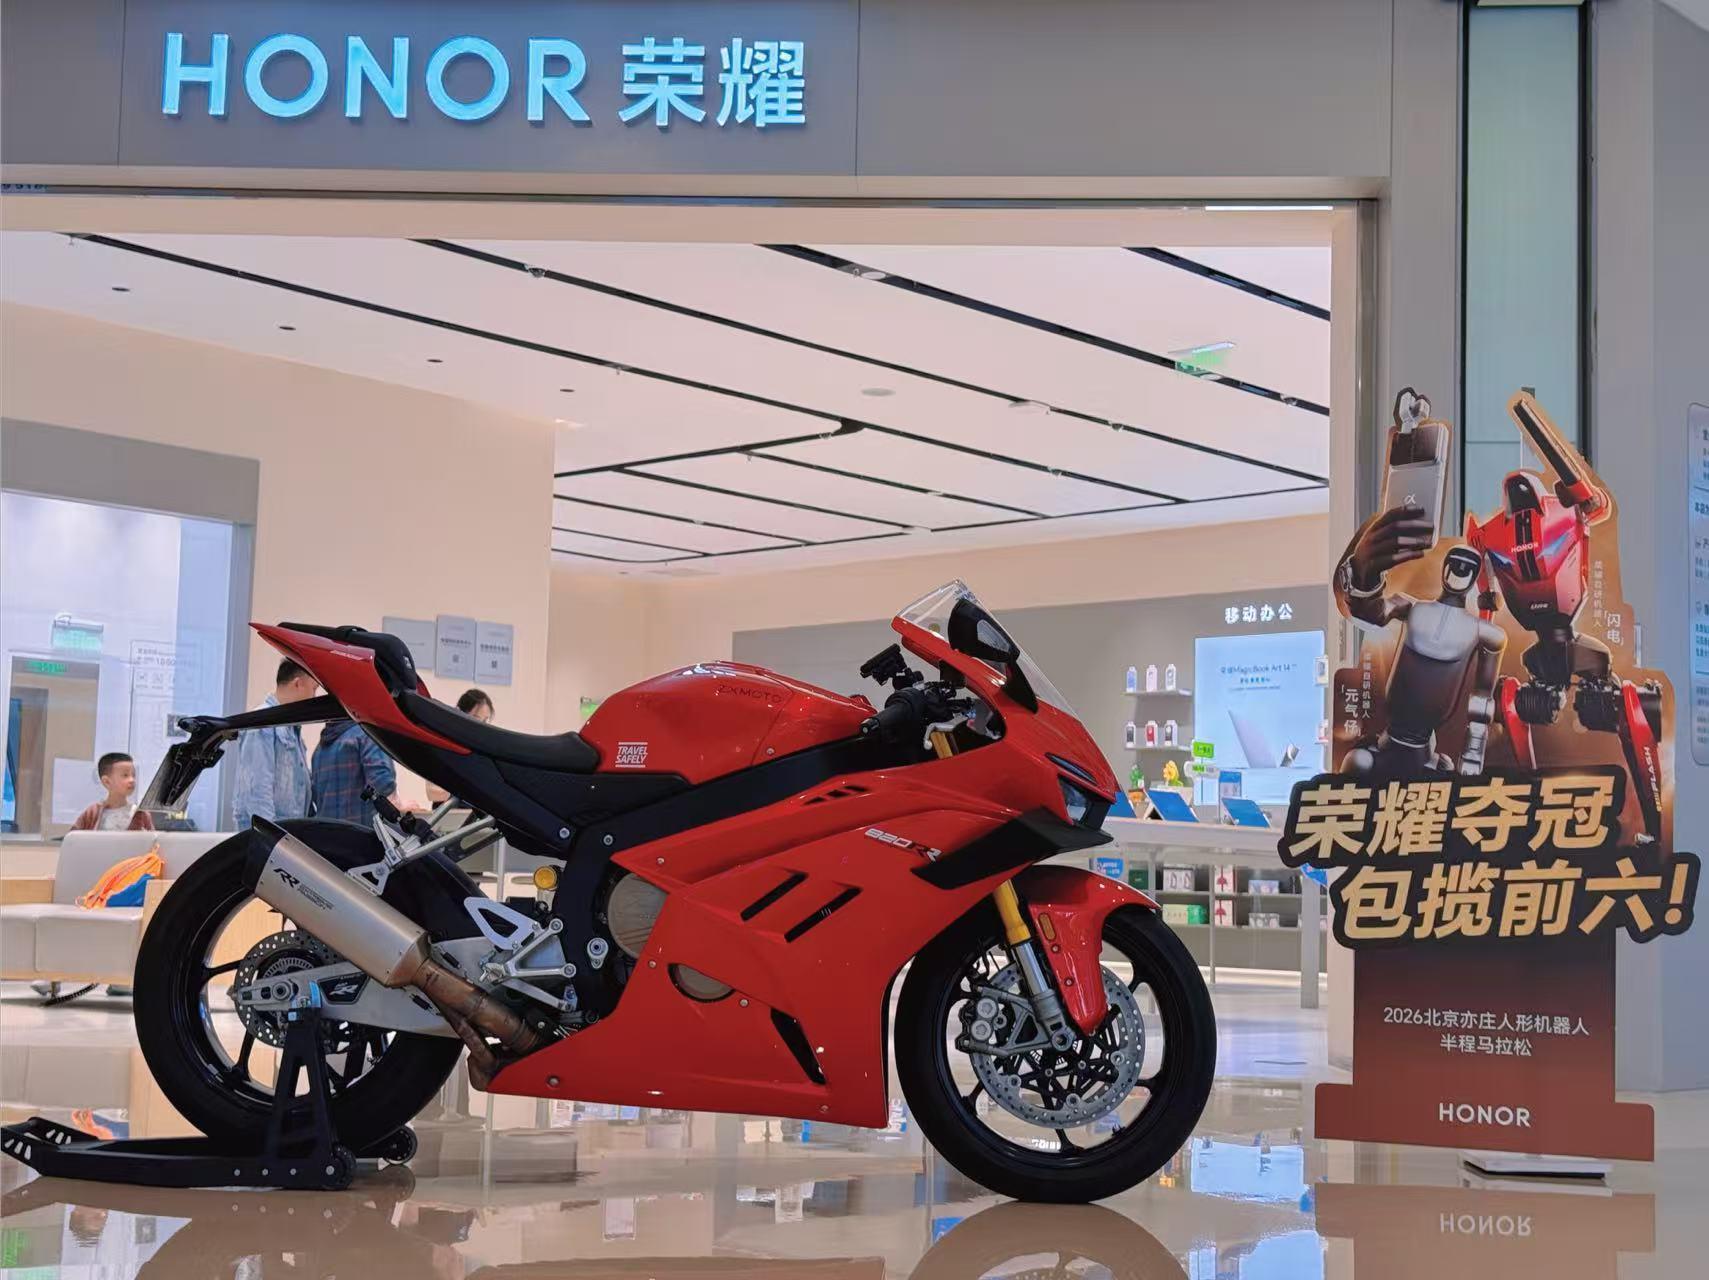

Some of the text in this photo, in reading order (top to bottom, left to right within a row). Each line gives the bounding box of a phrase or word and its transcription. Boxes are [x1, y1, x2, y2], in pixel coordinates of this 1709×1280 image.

[161, 32, 806, 128] HONOR 荣耀
[1225, 603, 1293, 624] 移动办公
[615, 754, 647, 764] SAFELY
[618, 746, 648, 755] TRAVEL
[1287, 776, 1615, 858] 荣耀夺冠
[1384, 1007, 1589, 1035] 2026北京亦庄人形机器人
[1440, 1033, 1532, 1057] 半程马拉松
[1439, 1102, 1531, 1128] HONOR
